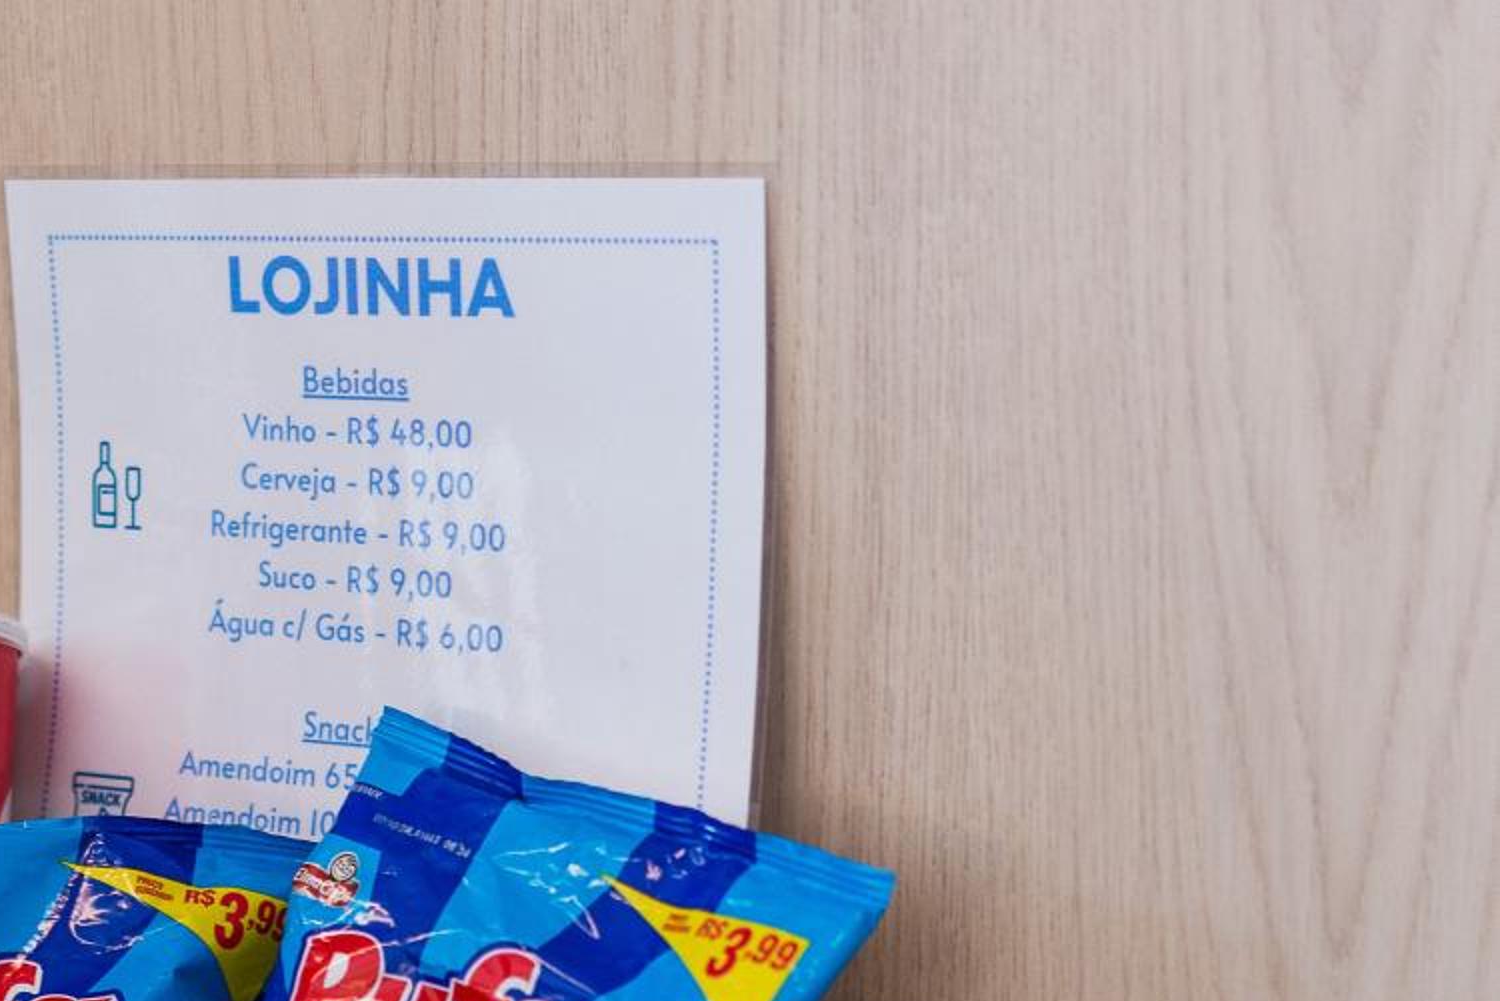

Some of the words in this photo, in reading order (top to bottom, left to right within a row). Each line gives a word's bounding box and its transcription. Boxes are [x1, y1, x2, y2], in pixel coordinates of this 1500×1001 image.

[227, 254, 517, 319] LOJINHA
[302, 365, 410, 398] Bebidas
[243, 414, 317, 445] Vinho
[346, 416, 380, 449] R$
[389, 417, 473, 450] 48,00
[241, 463, 338, 501] Cerveja
[367, 466, 401, 499] R$
[411, 470, 475, 502] 9,00
[210, 510, 368, 551] Refrigerante
[399, 518, 433, 552] R$
[443, 521, 506, 555] 9,00
[258, 561, 317, 592] Suco
[346, 566, 379, 599] R$
[389, 568, 453, 602] 9,00
[208, 598, 274, 643] Água
[283, 608, 306, 643] c/
[315, 610, 366, 645] Gás
[396, 616, 430, 651] R$
[440, 619, 504, 655] 6,00
[302, 711, 373, 745] Snac
[179, 751, 315, 789] Amendoim
[164, 798, 302, 834] Amendoim
[185, 889, 216, 909] R$
[696, 917, 728, 940] R$
[706, 927, 798, 979] 3,99
